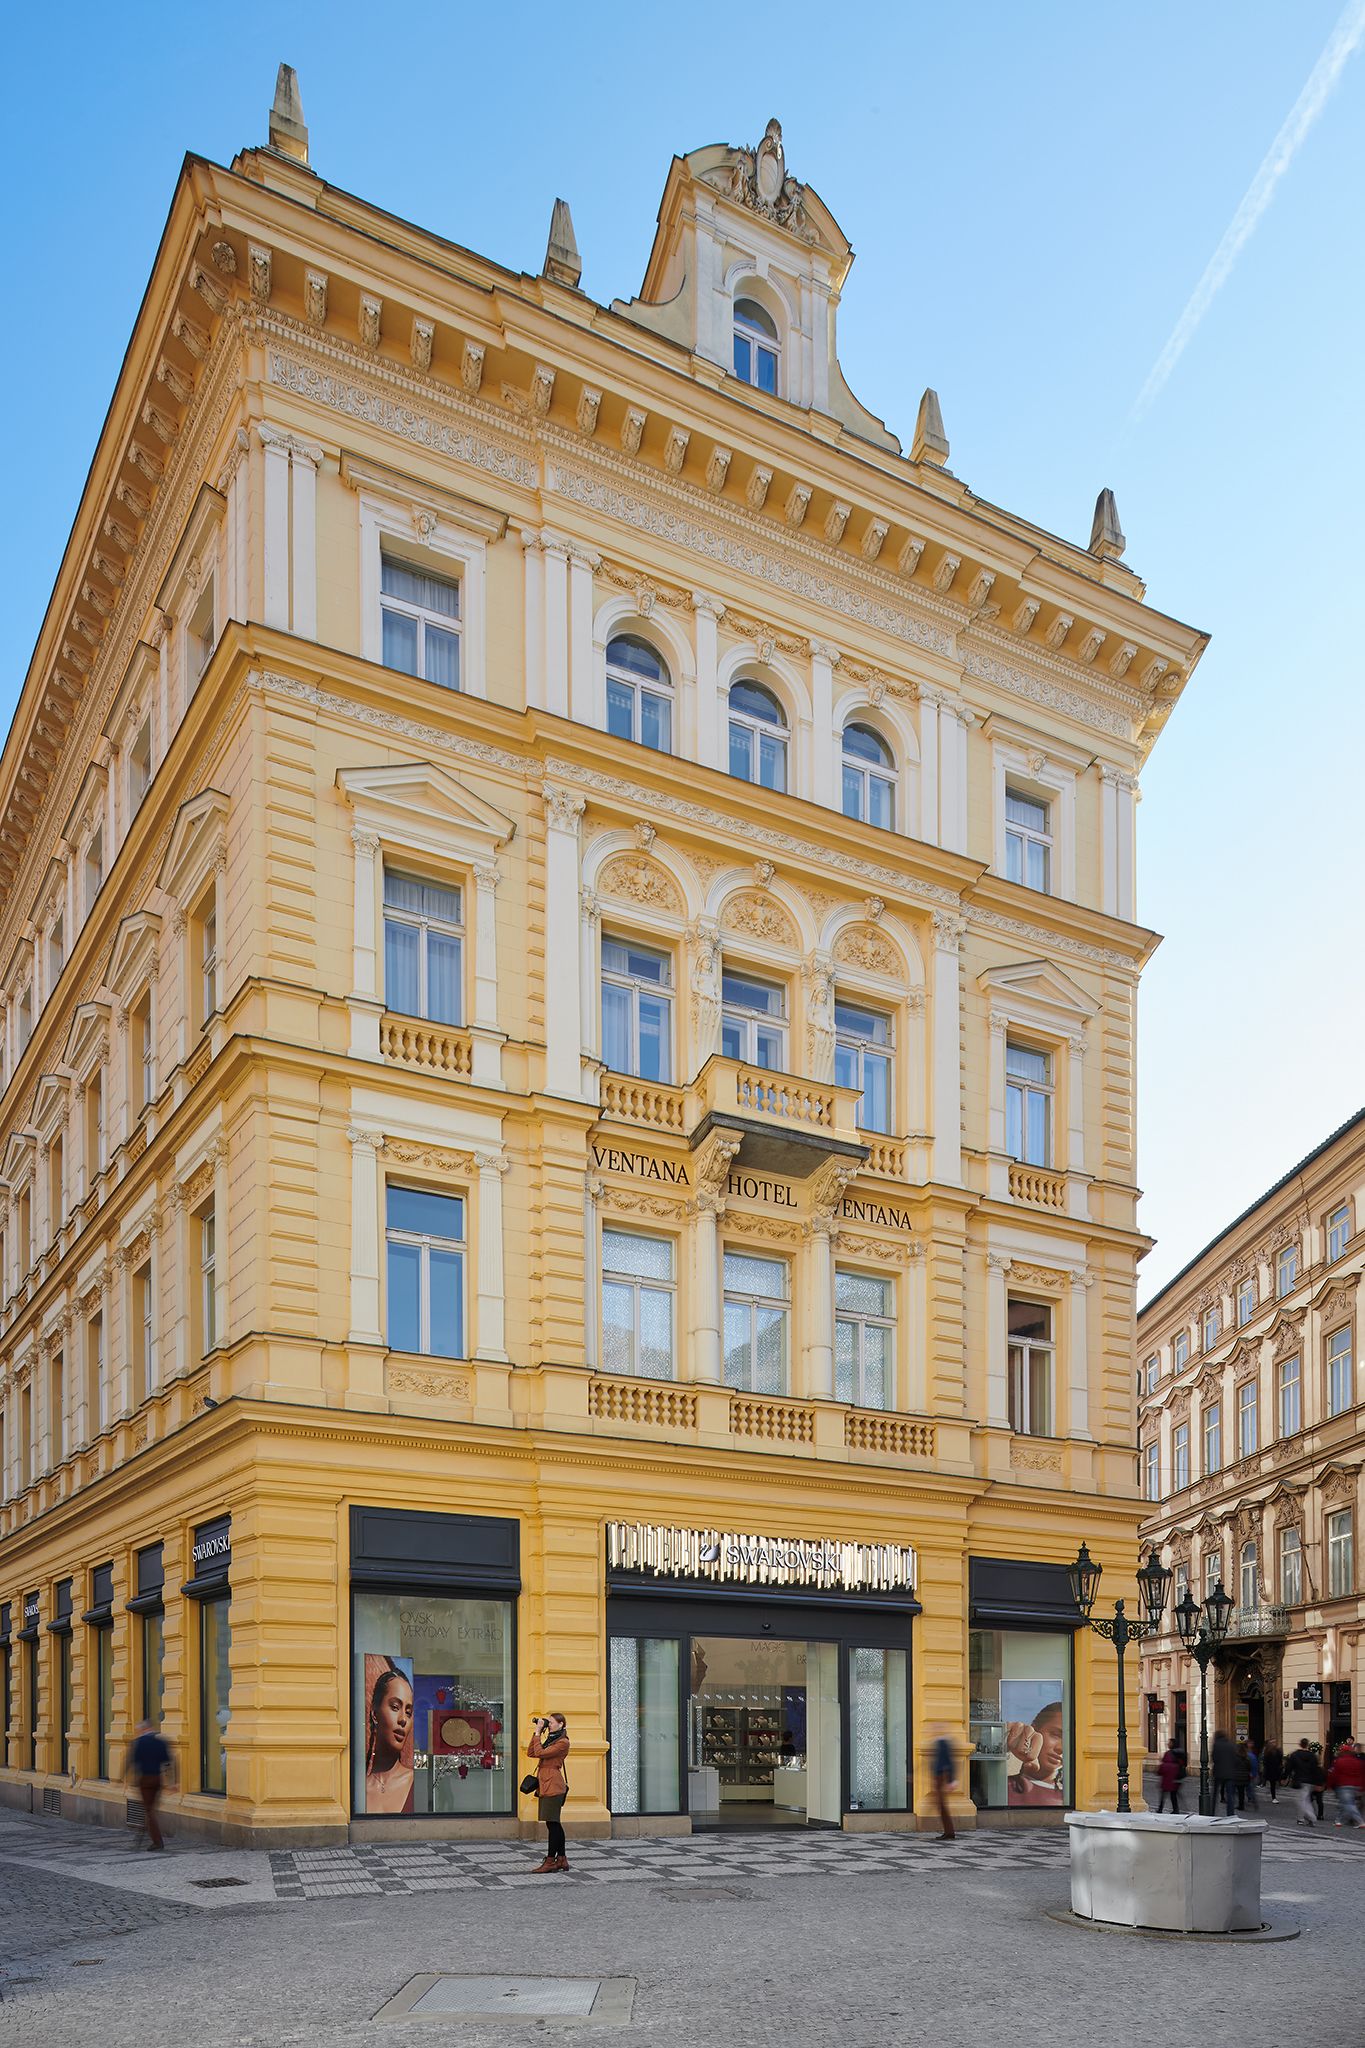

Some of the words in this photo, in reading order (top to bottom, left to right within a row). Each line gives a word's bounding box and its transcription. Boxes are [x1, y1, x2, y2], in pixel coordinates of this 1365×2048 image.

[592, 1146, 691, 1186] VENTANA
[727, 1174, 799, 1208] HOTEL
[192, 1534, 230, 1562] SWAROVSKI
[726, 1544, 843, 1572] SWAROVSKI
[400, 1611, 436, 1624] OVSKI
[401, 1624, 450, 1639] VERYDAY
